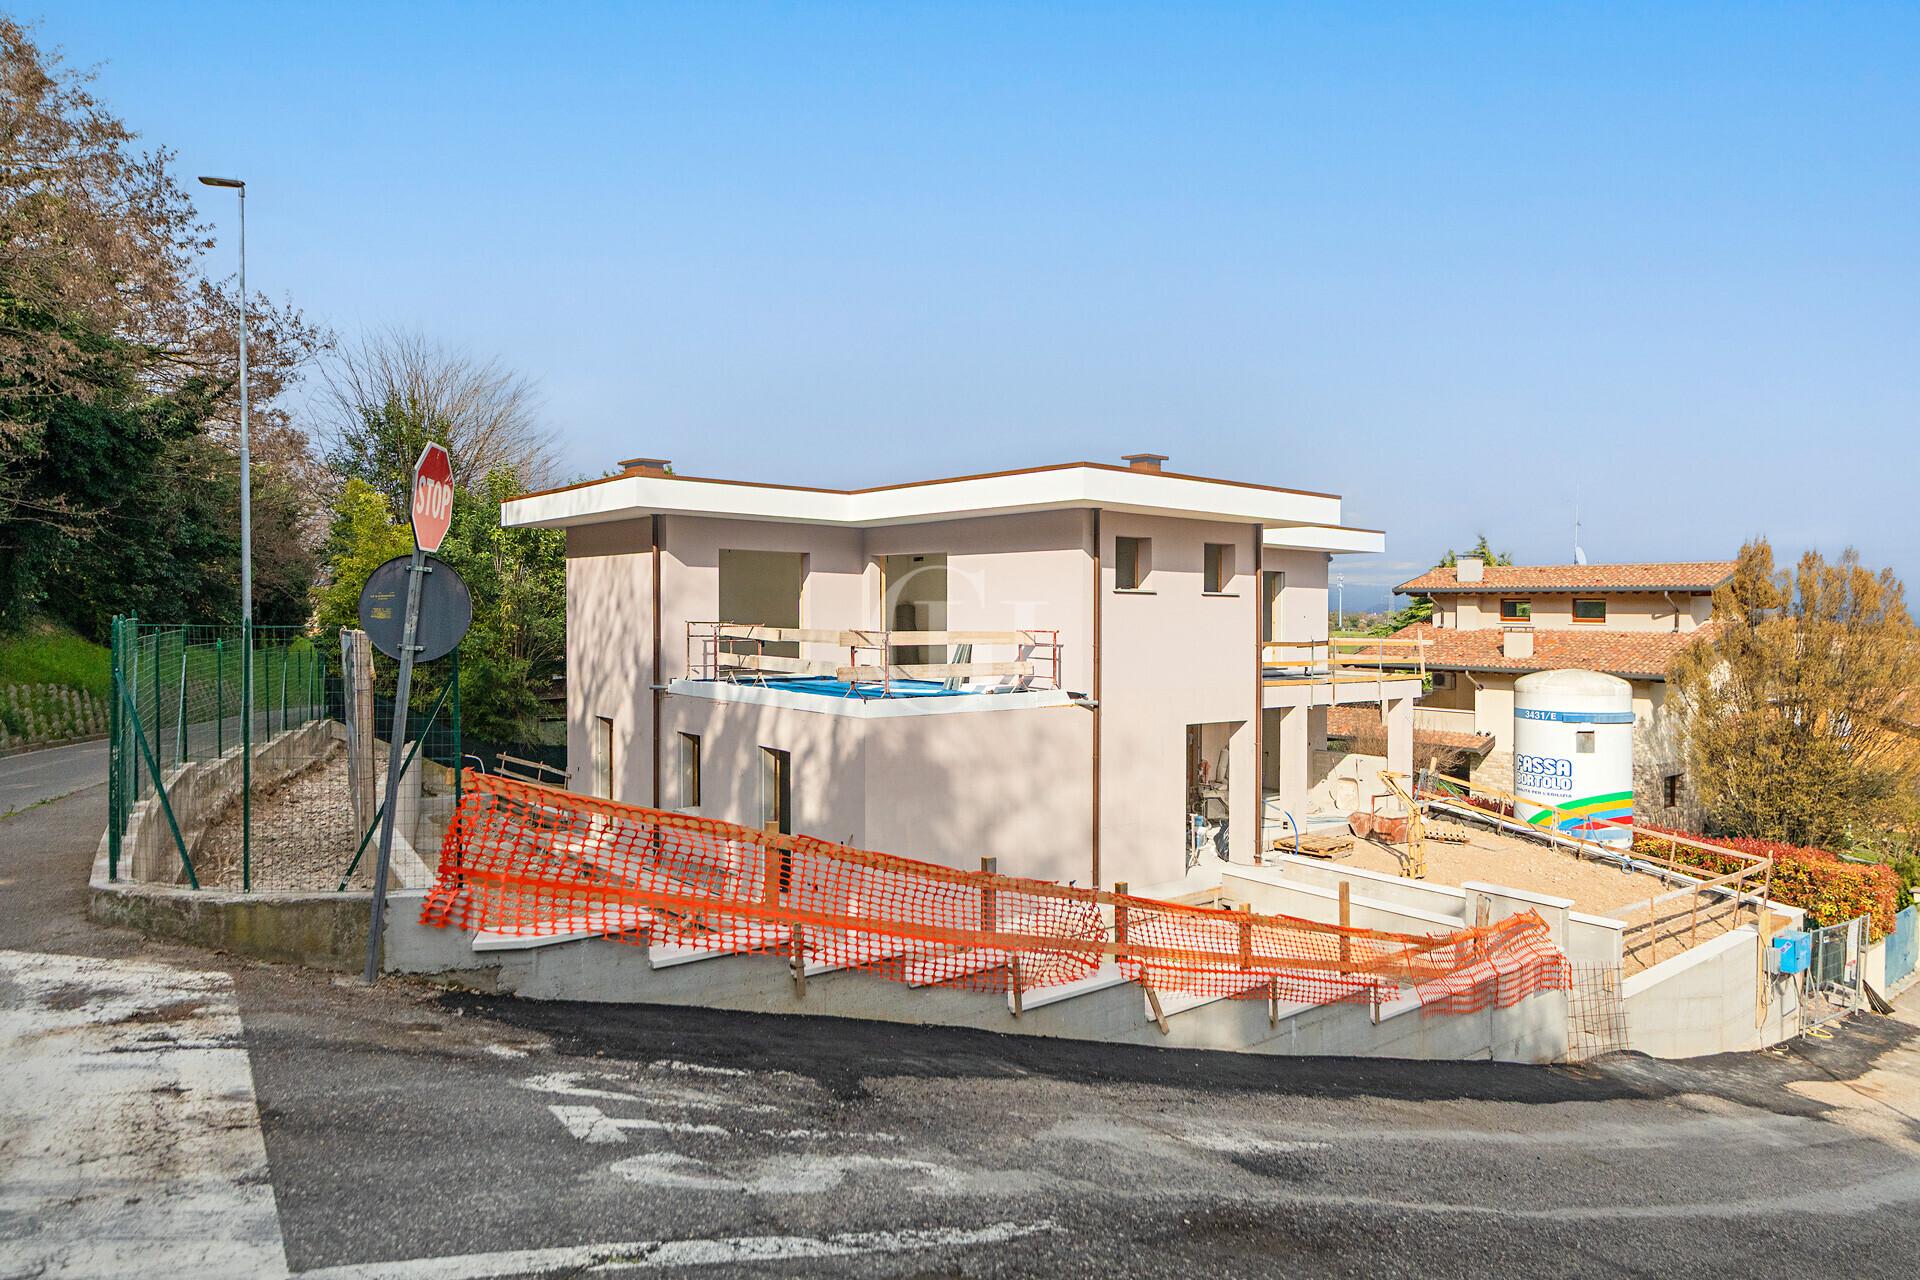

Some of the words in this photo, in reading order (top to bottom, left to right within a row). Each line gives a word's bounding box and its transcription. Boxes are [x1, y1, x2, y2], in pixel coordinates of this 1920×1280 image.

[415, 475, 450, 521] STOP
[1525, 710, 1557, 720] 3431/E
[1516, 754, 1572, 777] FASSA
[1516, 771, 1573, 790] BORTOLO
